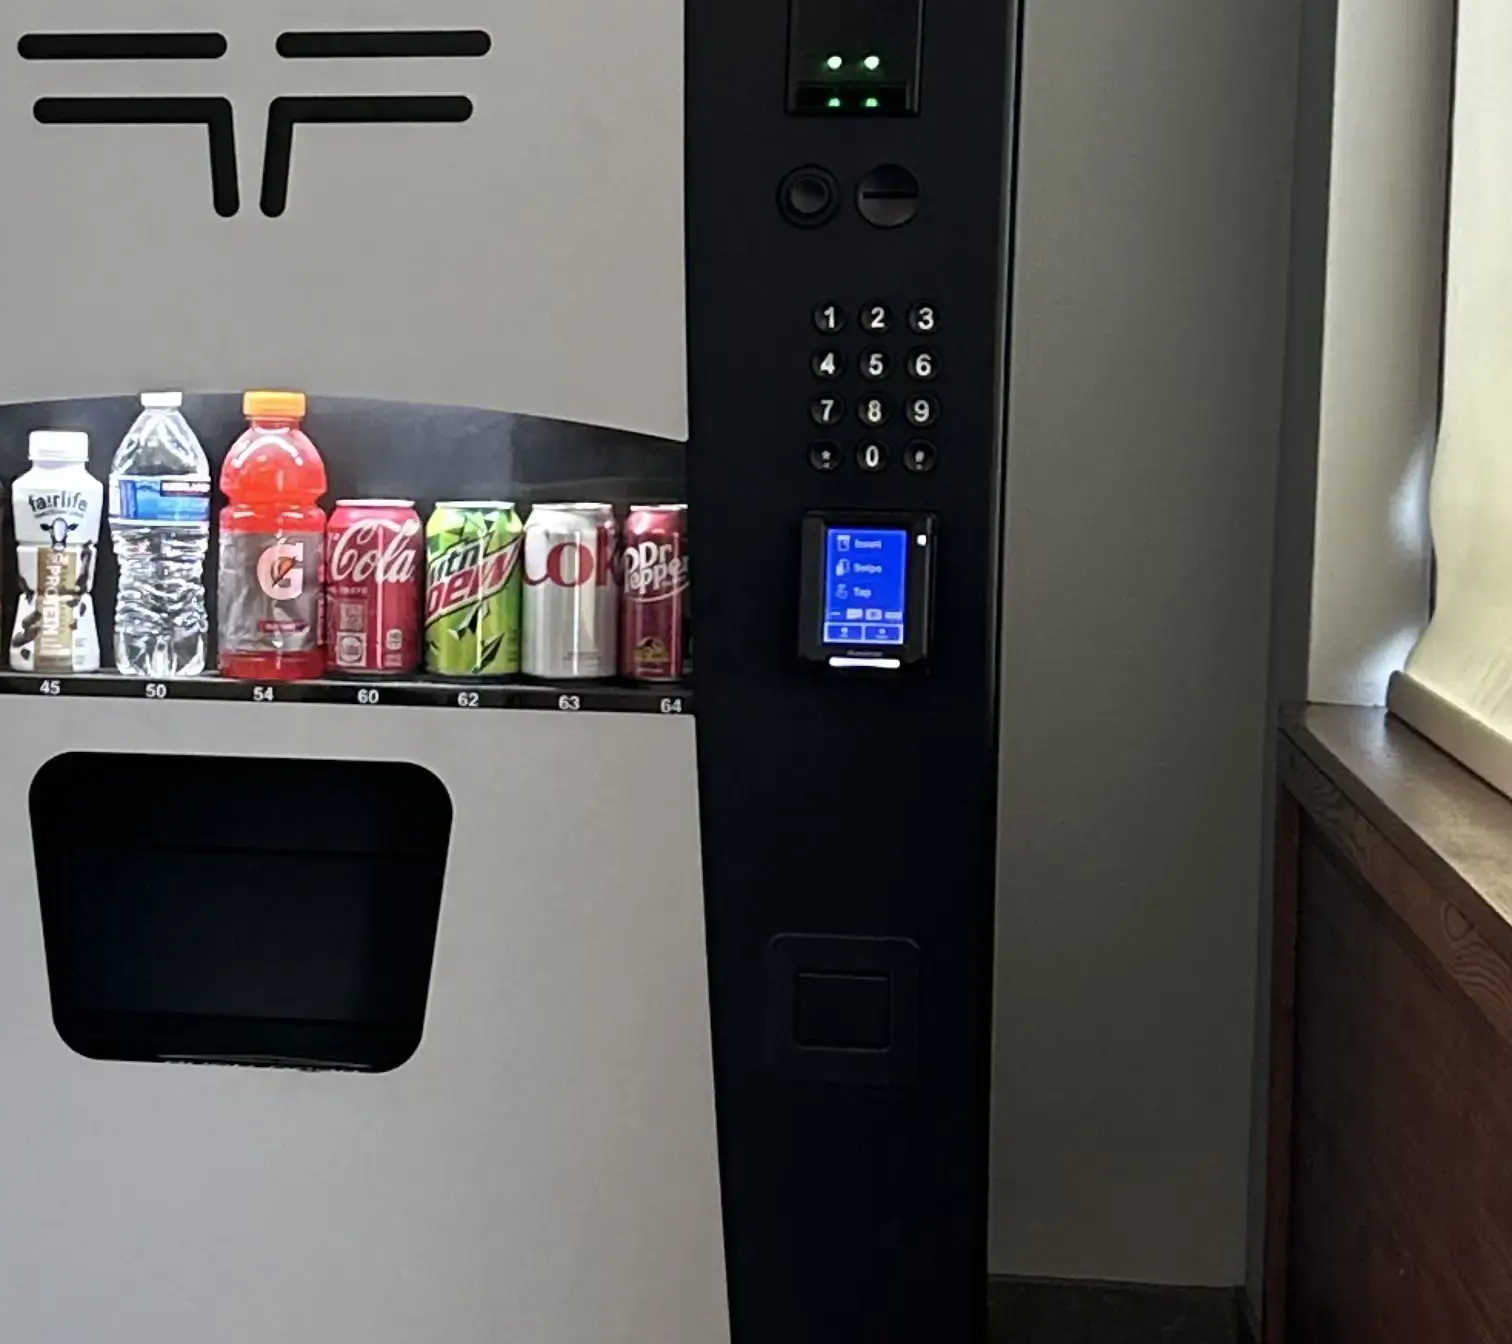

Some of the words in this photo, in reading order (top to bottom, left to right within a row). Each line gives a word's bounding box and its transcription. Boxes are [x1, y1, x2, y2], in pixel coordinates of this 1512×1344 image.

[823, 306, 835, 329] 1
[870, 306, 885, 329] 2
[917, 306, 934, 330] 3
[819, 352, 836, 375] 4
[868, 353, 884, 376] 5
[915, 353, 932, 376] 6
[819, 399, 834, 422] 7
[867, 399, 882, 423] 8
[913, 399, 930, 423] 9
[865, 444, 879, 468] 0
[28, 490, 89, 513] fairlife
[639, 541, 673, 569] Dr
[256, 542, 304, 600] G
[853, 562, 882, 574] Swipe
[853, 586, 872, 599] Tap
[40, 680, 61, 694] 45
[146, 684, 166, 698] 50
[253, 686, 274, 701] 54
[357, 689, 379, 704] 60
[457, 692, 479, 707] 62
[559, 694, 580, 710] 63
[661, 697, 682, 713] 64
